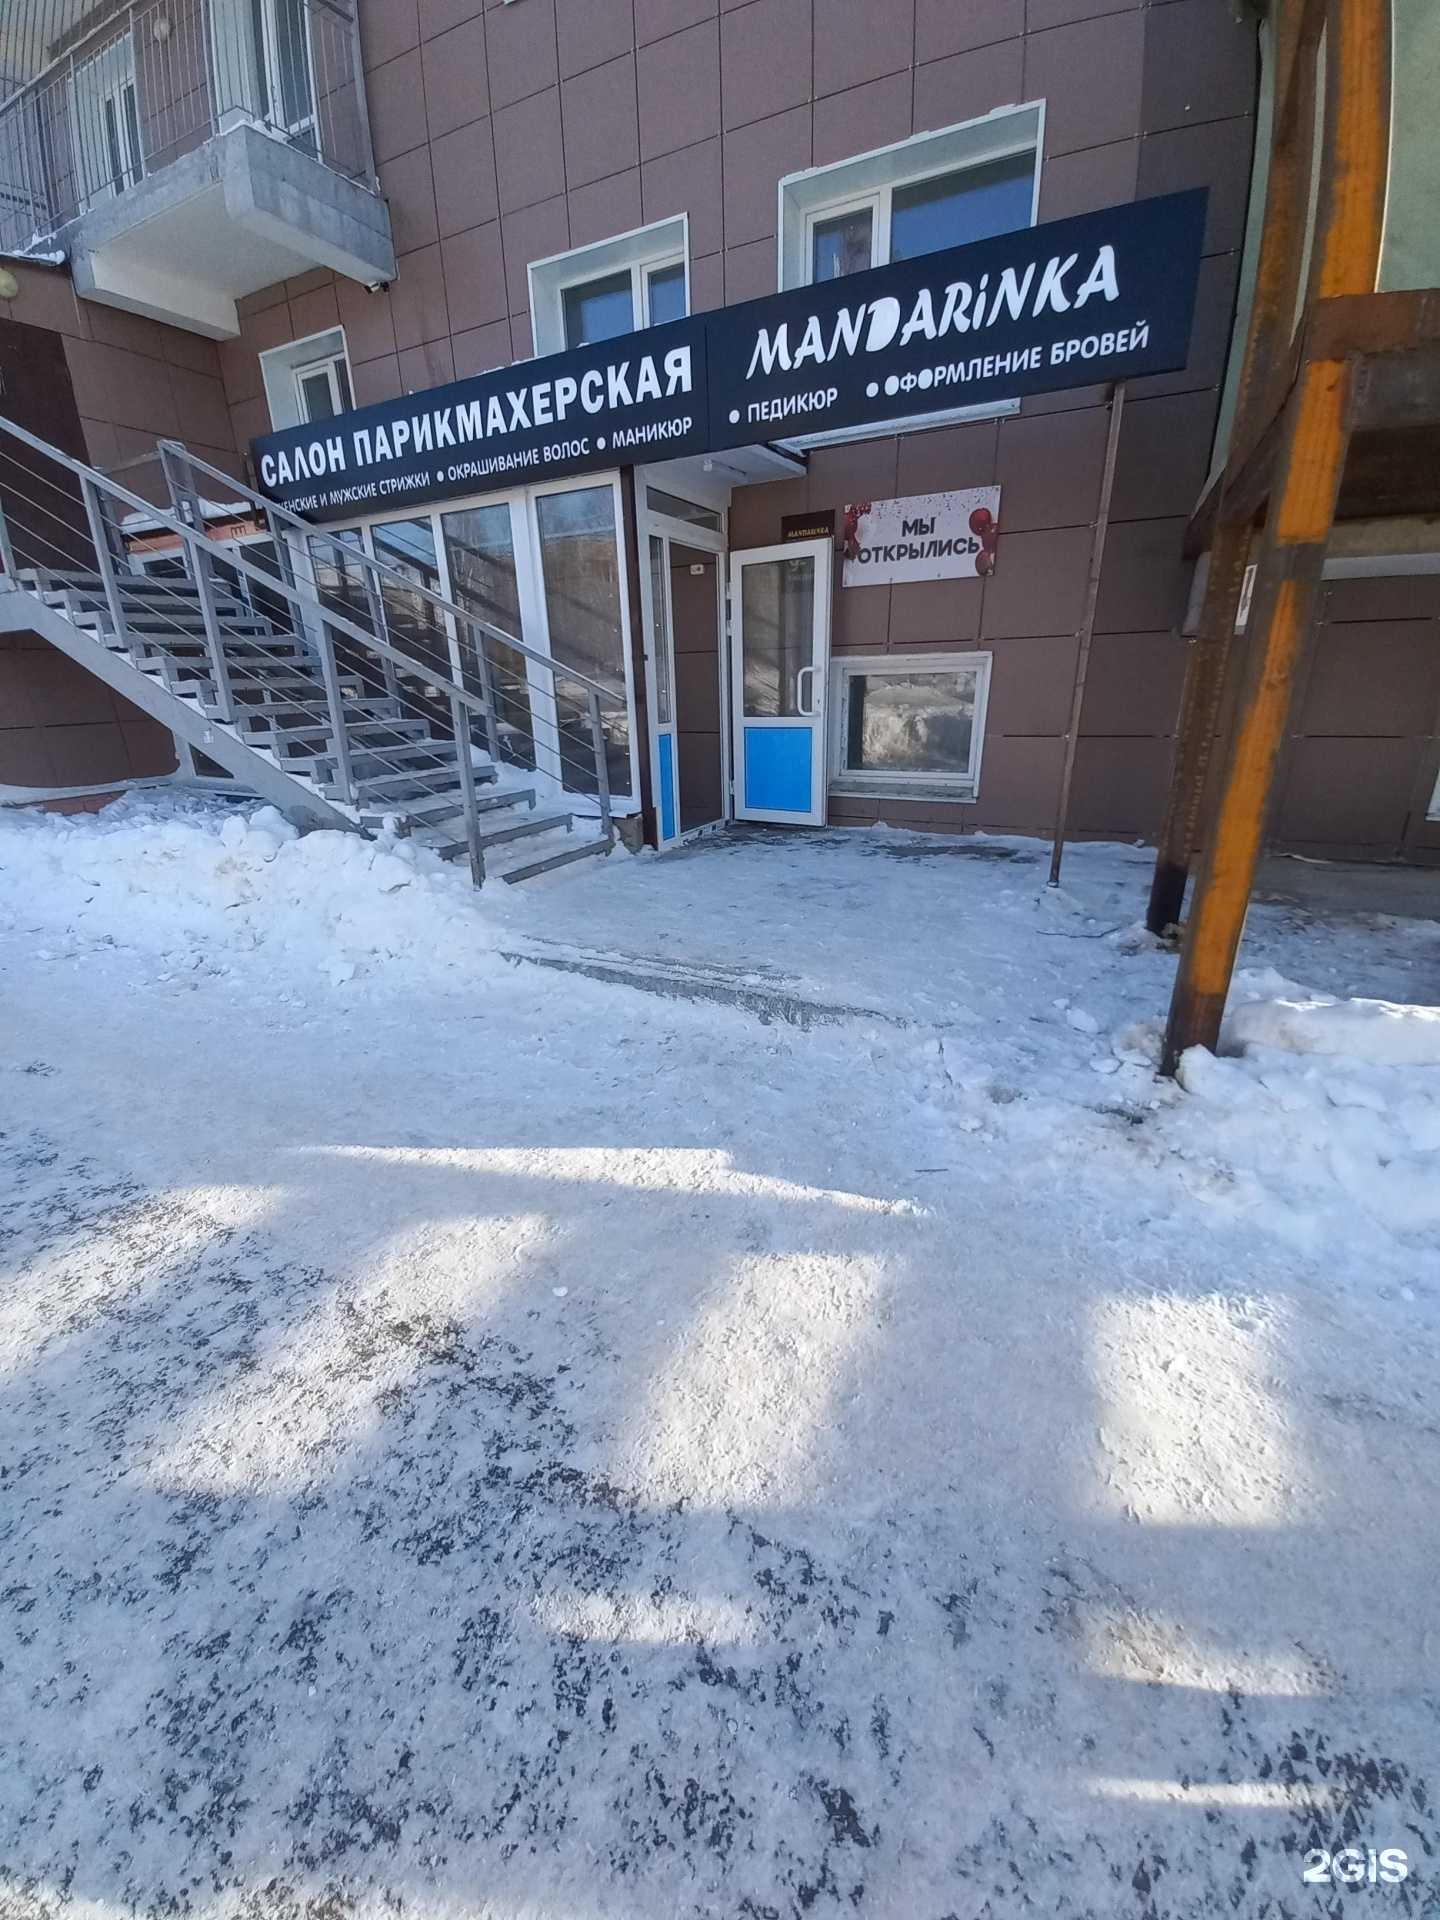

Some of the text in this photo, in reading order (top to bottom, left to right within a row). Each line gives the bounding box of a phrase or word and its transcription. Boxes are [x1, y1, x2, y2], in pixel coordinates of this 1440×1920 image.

[261, 345, 692, 488] САЛОН ПАРИКМАХЕРСКАЯ
[748, 388, 838, 423] ПЕДИКЮР
[1050, 321, 1150, 364] БРОВЕЙ
[319, 492, 328, 507] И
[329, 483, 377, 506] МУЖСКИЕ
[379, 471, 430, 493] СТРИЖКИ
[448, 448, 540, 482] ОКРАШИВАНИЕ
[543, 437, 590, 462] ВОЛОС
[612, 416, 692, 449] МАНИКЮР
[858, 537, 980, 564] ОТКРЫЛИСЬ
[902, 517, 936, 537] МЫ
